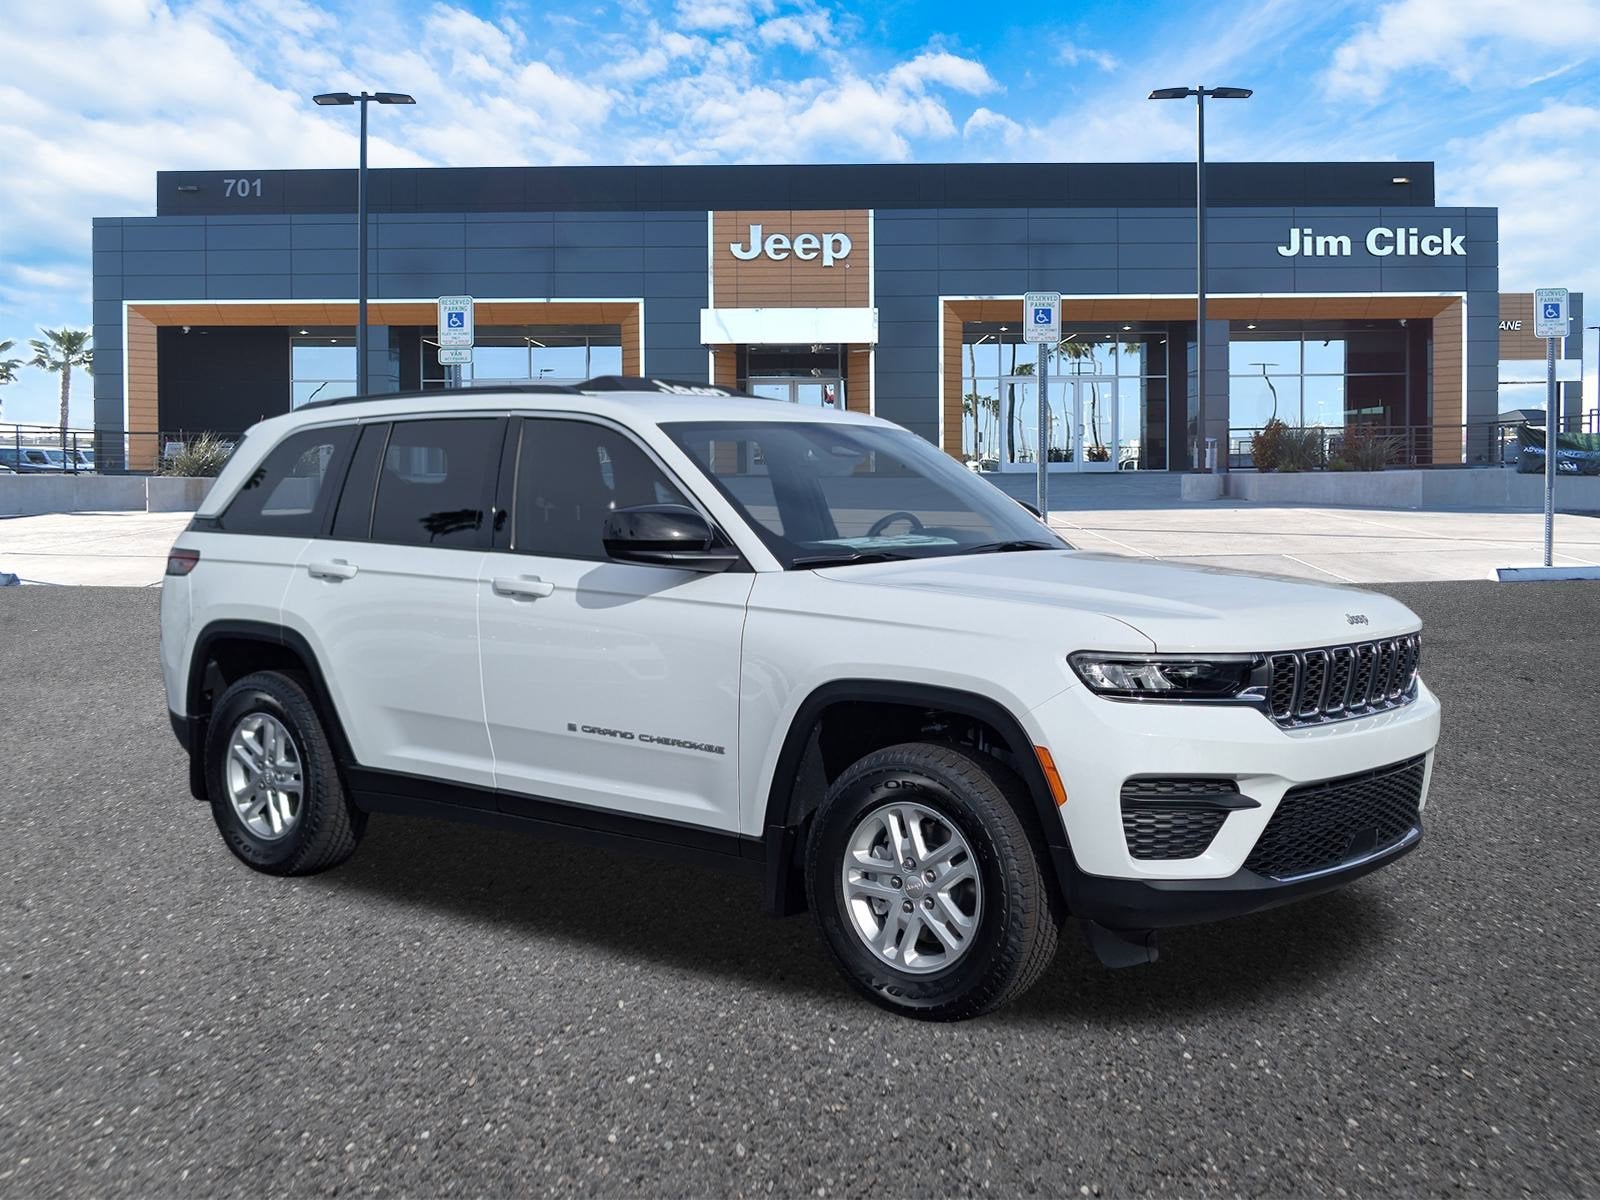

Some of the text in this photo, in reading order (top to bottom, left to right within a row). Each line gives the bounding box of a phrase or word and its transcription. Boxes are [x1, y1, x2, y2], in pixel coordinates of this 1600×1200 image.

[224, 178, 262, 197] 701
[729, 224, 852, 267] Jeep
[1277, 227, 1467, 257] Jim Click
[1499, 320, 1522, 331] ANE
[1345, 613, 1369, 626] Jeep
[581, 725, 726, 755] GRAND CHEROKEE
